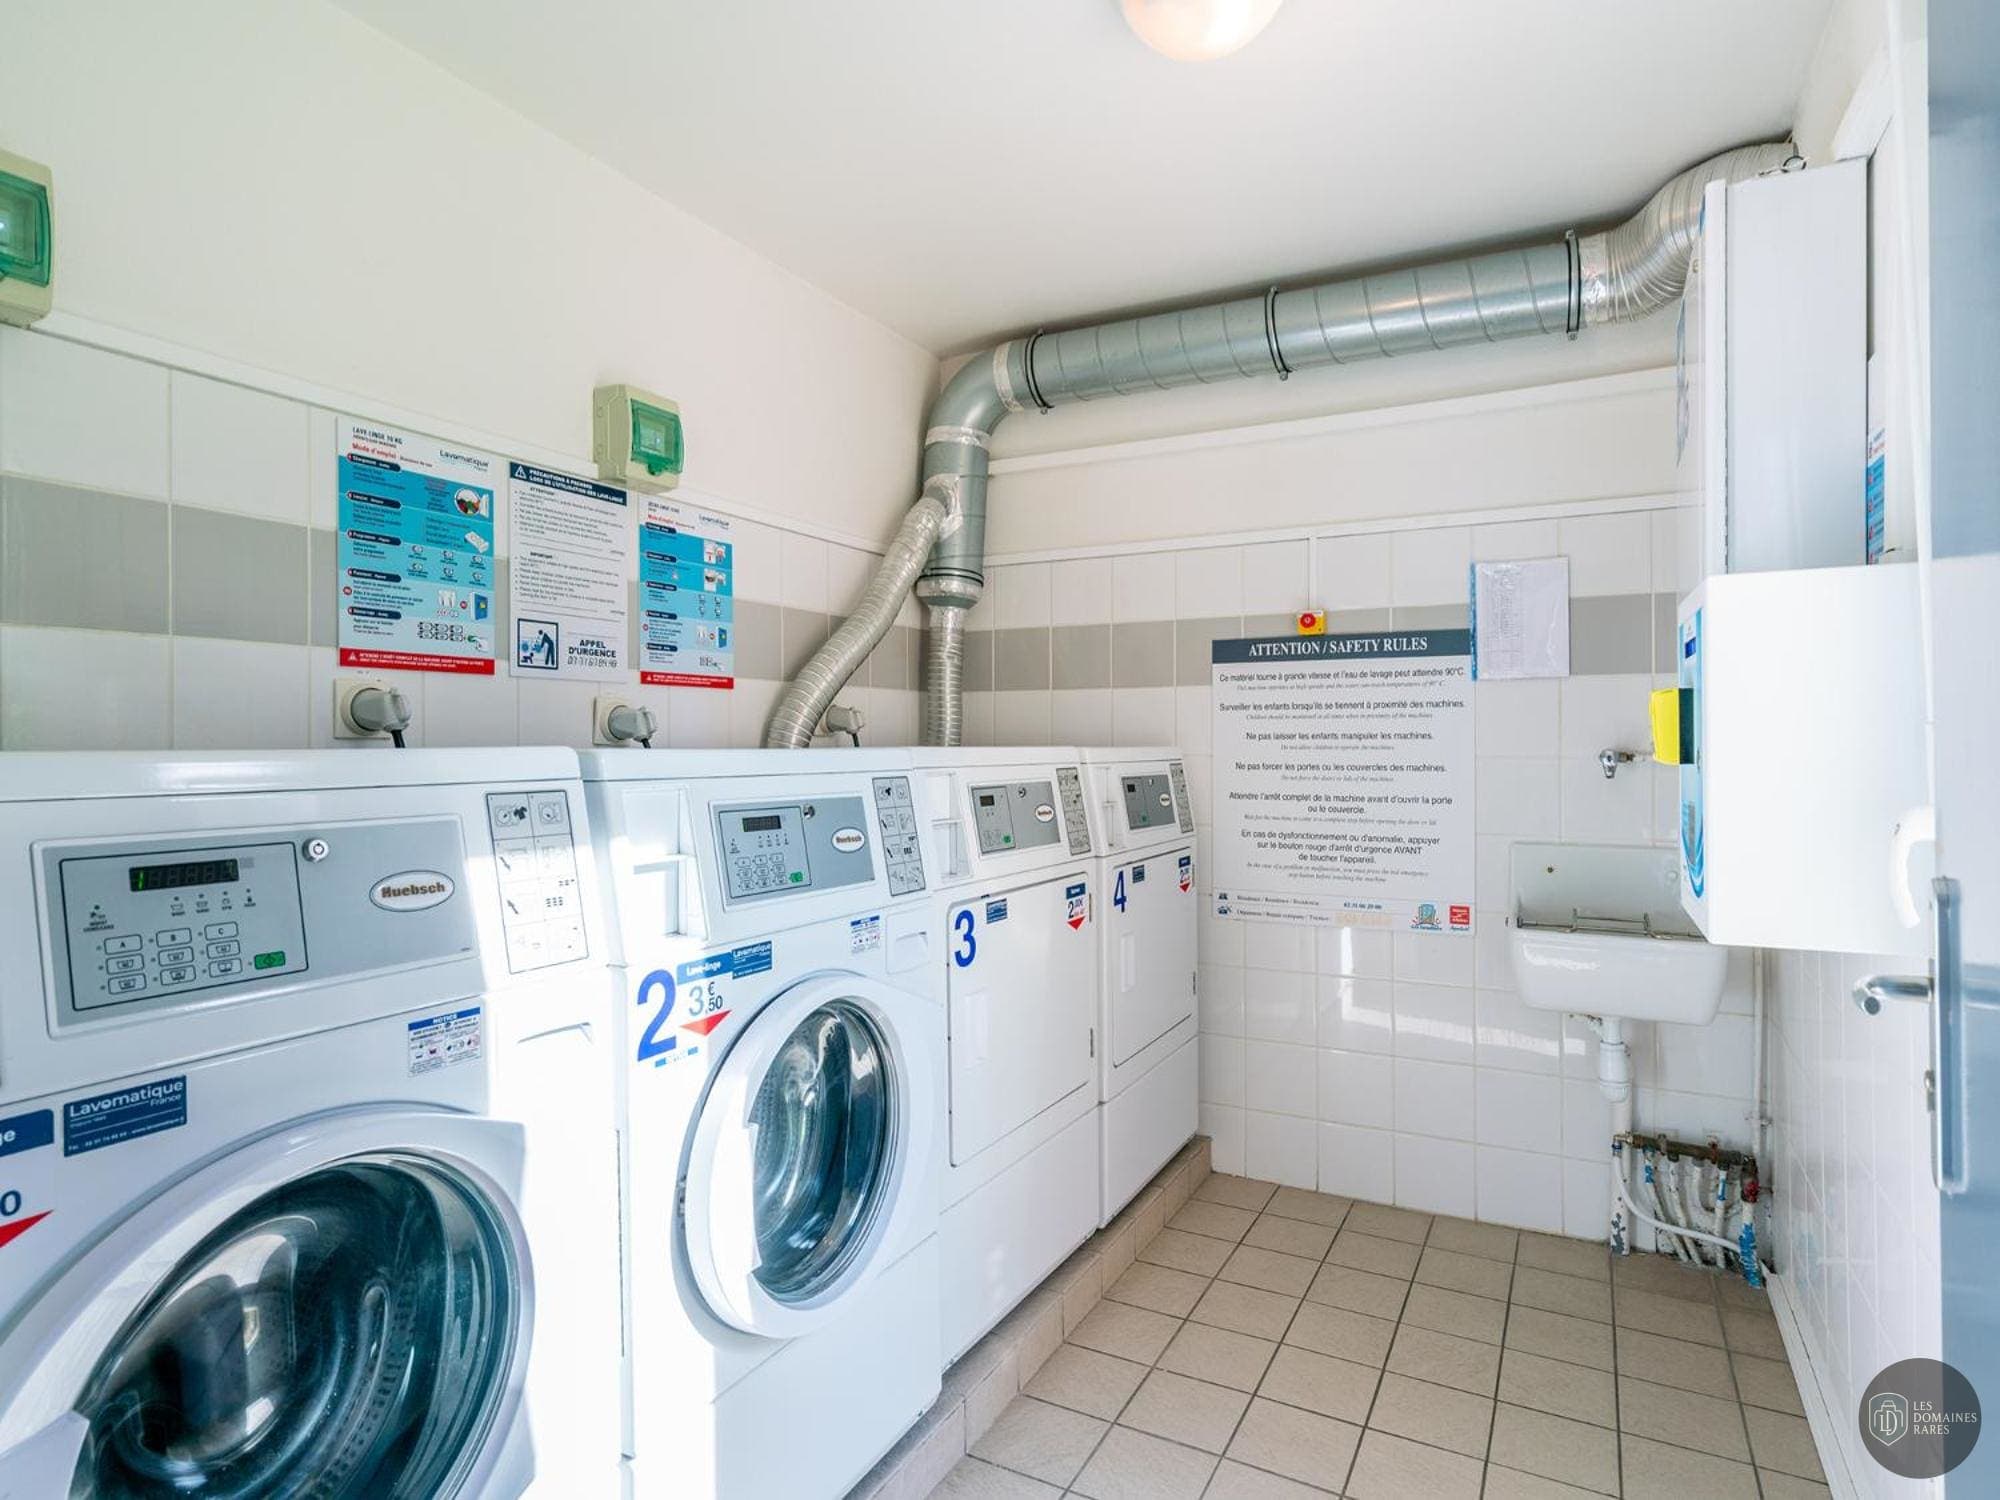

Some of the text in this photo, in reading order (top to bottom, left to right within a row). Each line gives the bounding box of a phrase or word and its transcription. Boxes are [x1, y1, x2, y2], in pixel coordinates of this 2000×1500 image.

[440, 450, 489, 467] Lavomatique
[580, 640, 606, 648] APPEL
[1248, 637, 1428, 656] ATTENTION / SAFETY RULES
[568, 647, 616, 658] D'URGENCE
[1219, 673, 1229, 681] Ce
[1278, 672, 1283, 680] à
[1359, 669, 1368, 678] de
[1366, 700, 1371, 708] à
[1246, 731, 1257, 739] Ne
[1235, 761, 1246, 770] Ne
[1313, 793, 1322, 802] de
[1324, 793, 1331, 802] la
[1421, 795, 1430, 804] la
[1319, 804, 1326, 813] le
[1241, 829, 1252, 838] En
[1267, 830, 1277, 838] de
[1269, 840, 1277, 849] le
[1298, 852, 1308, 861] de
[381, 882, 445, 898] Huebsch
[1113, 870, 1127, 913] 4
[1068, 900, 1074, 919] 2
[954, 910, 976, 967] 3
[689, 986, 704, 1016] 3
[636, 969, 677, 1062] 2
[70, 1081, 183, 1117] Lavomatique
[150, 1094, 181, 1106] France
